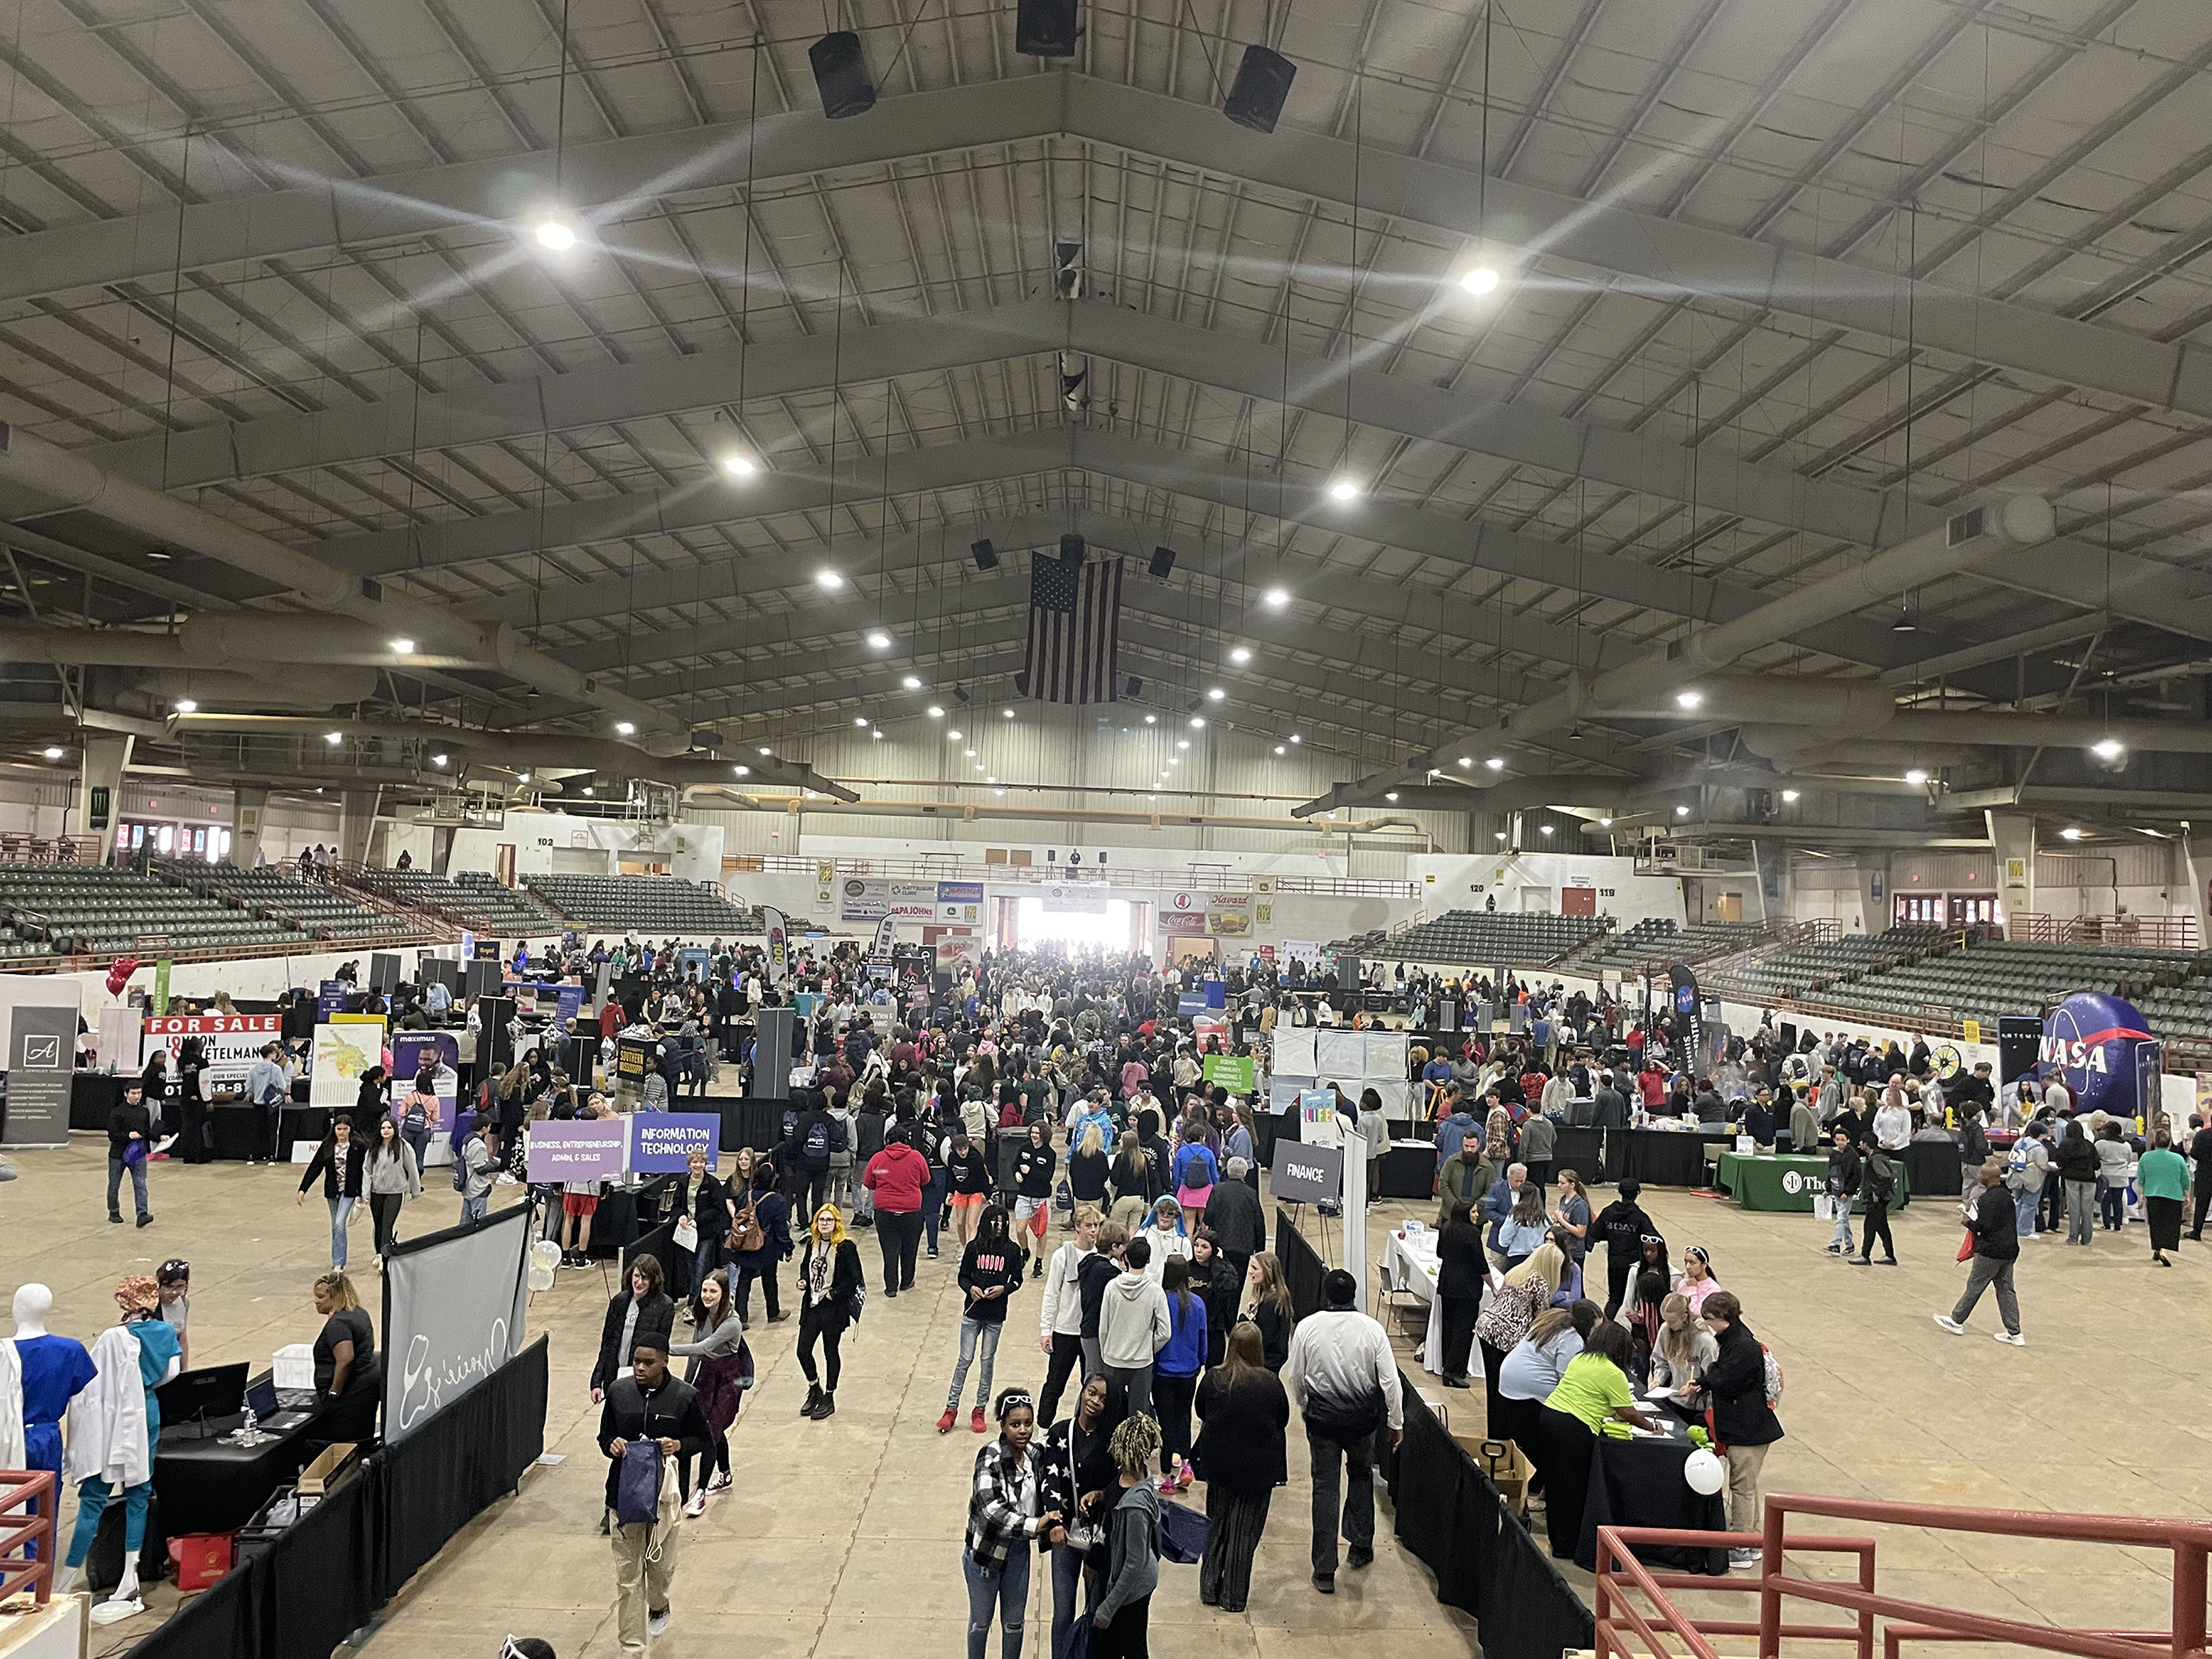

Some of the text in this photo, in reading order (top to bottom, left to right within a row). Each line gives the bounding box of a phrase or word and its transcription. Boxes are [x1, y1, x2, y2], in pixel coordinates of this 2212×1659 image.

[1599, 888, 1615, 896] 119
[1212, 895, 1249, 904] Havard
[151, 1017, 275, 1032] FOR SALE
[205, 1047, 259, 1060] ETELMAN
[2038, 1035, 2107, 1073] NASA
[1305, 1109, 1332, 1122] LIFE
[641, 1128, 710, 1140] INFORMATION
[530, 1141, 561, 1150] BUSINESS,
[641, 1142, 709, 1155] TECHNOLOGY
[552, 1154, 573, 1162] ADMIN,
[580, 1153, 601, 1162] SALES
[1287, 1163, 1325, 1183] FINANCE
